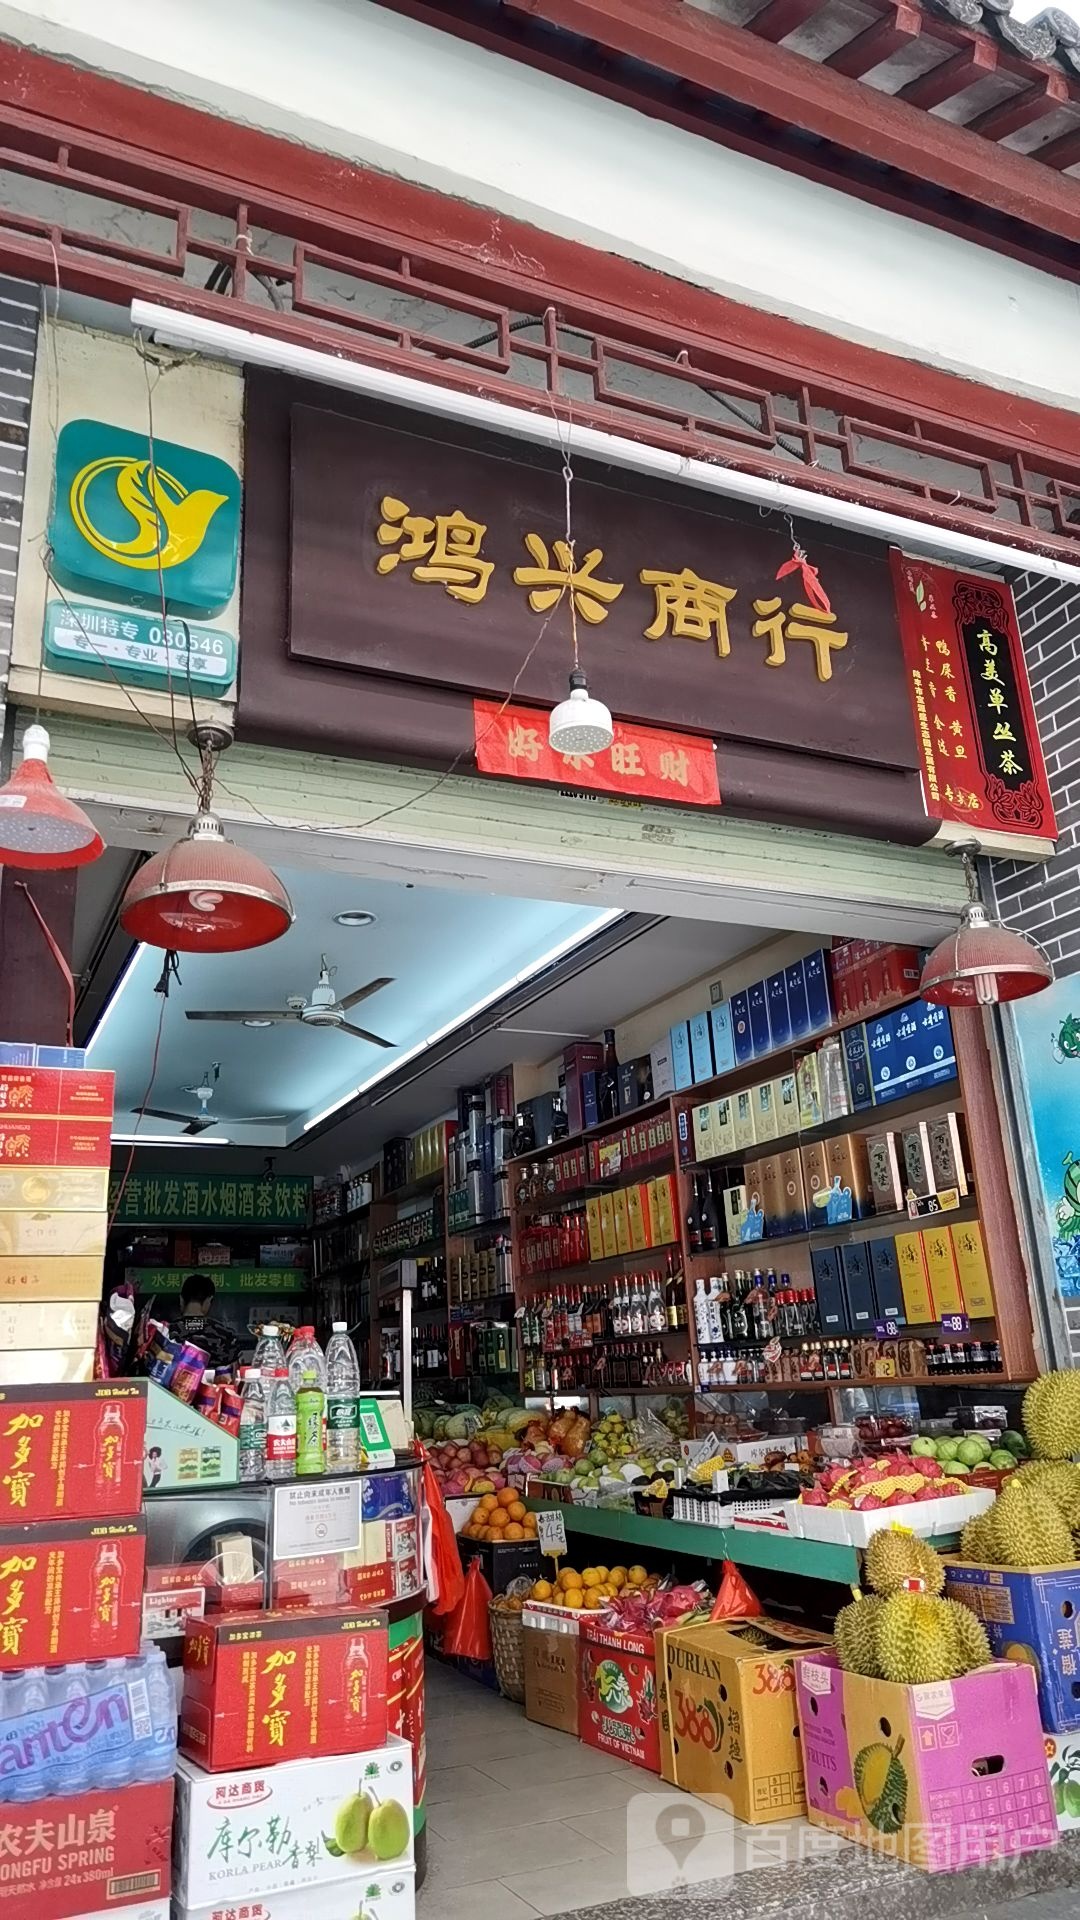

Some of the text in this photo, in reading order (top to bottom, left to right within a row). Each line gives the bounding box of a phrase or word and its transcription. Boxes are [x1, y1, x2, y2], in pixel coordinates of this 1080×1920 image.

[377, 496, 849, 683] 鸿兴商行
[60, 608, 224, 656] 深圳特专 030546
[977, 629, 1024, 775] 高美单丛茶
[928, 1199, 938, 1212] 85
[151, 1273, 296, 1288] 水果制、批发零售
[600, 1634, 622, 1649] THANH
[623, 1639, 645, 1655] LONG
[667, 1643, 722, 1682] DURIAN
[752, 1663, 797, 1695] 388
[260, 1650, 297, 1747] 加多寶
[673, 1688, 716, 1750] 388
[597, 1732, 646, 1760] FRUIT OF VIETNAM
[807, 1746, 838, 1772] FRUITS
[215, 1780, 265, 1799] 阿达商贸
[0, 1808, 117, 1858] 农夫山泉
[207, 1815, 291, 1865] 库尔勒
[57, 1845, 115, 1872] SPRING
[208, 1858, 283, 1881] KORLA PEAR
